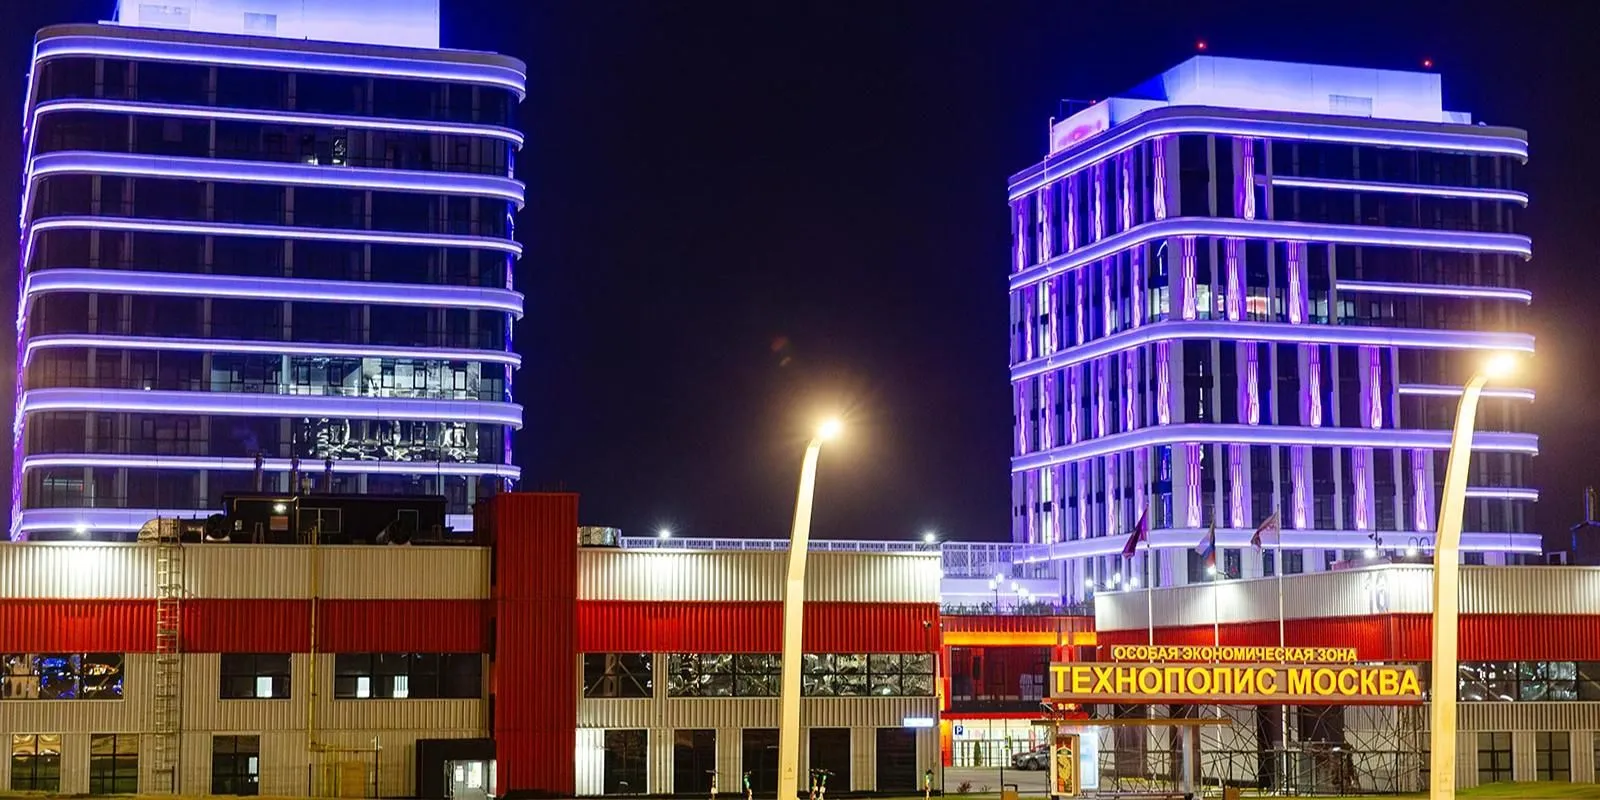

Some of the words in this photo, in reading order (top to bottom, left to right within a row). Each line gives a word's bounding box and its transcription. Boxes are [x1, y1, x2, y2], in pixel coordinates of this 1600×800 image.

[1115, 646, 1179, 660] ОСОБАЯ
[1182, 647, 1314, 662] ЭКОНОМИЧЕСКАЯ
[1317, 648, 1357, 662] ЗОНА
[1049, 665, 1277, 695] ТЕХНОПОЛИС
[1287, 666, 1421, 696] МОСКВА
